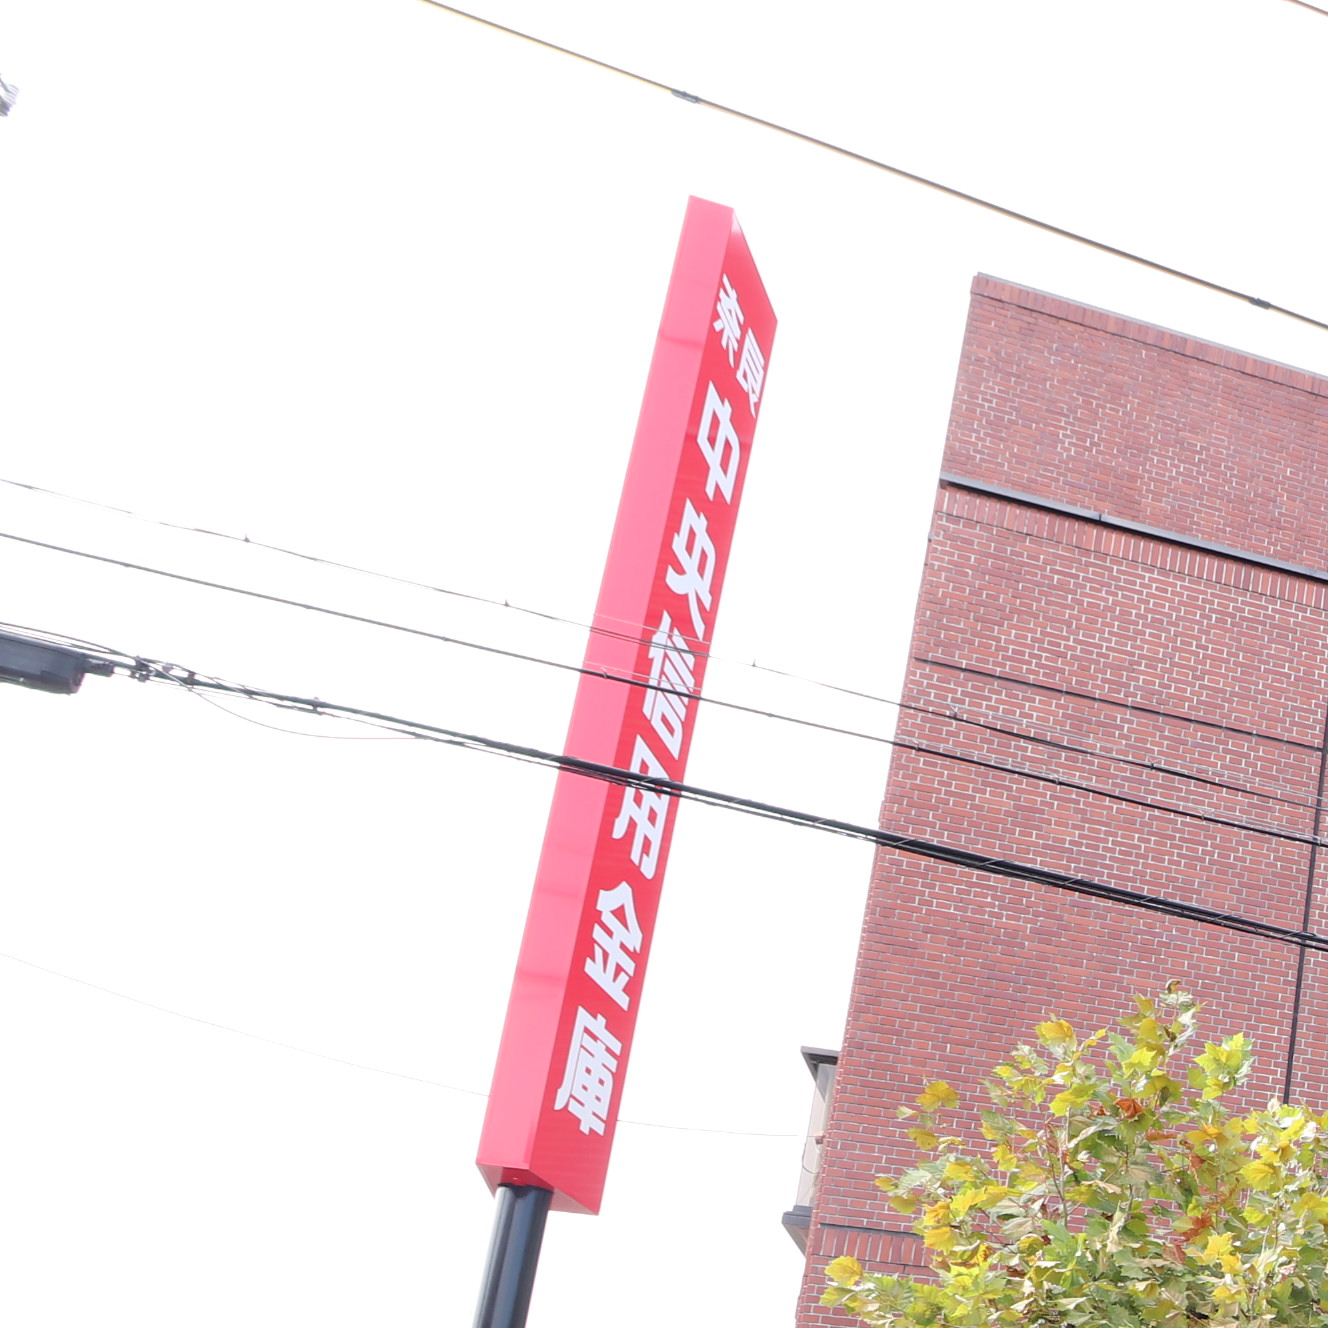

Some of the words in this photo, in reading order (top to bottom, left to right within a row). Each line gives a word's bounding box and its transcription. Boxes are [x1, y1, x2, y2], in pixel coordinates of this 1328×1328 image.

[713, 273, 765, 419] 奈良
[554, 380, 741, 1136] 中央信用金庫
